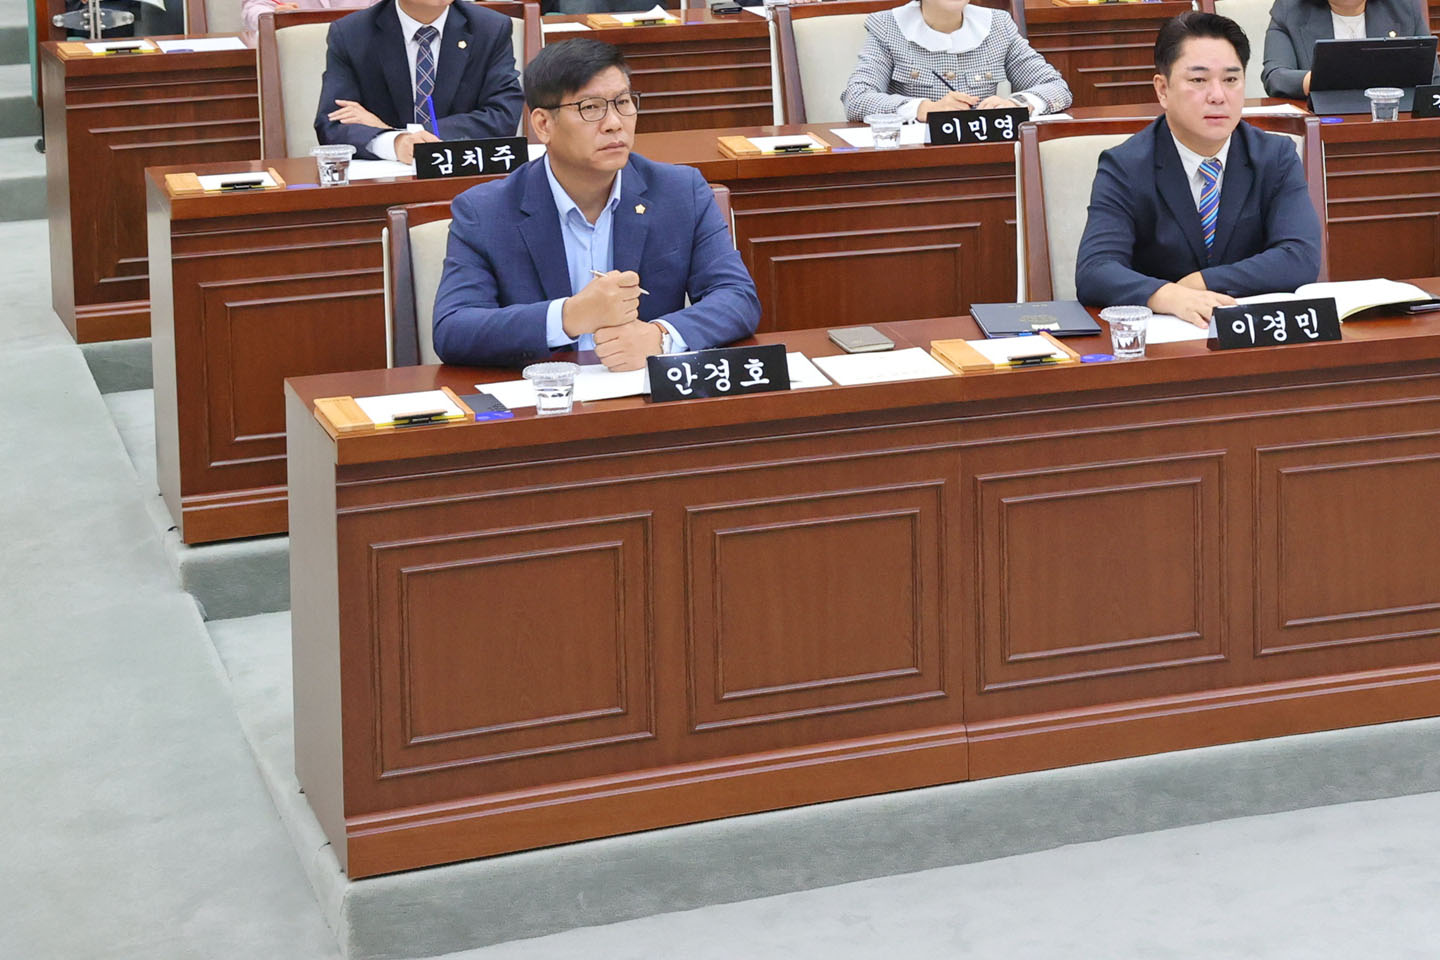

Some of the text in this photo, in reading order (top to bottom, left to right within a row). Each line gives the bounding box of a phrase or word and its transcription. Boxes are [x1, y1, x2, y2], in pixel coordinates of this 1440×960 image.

[941, 114, 1014, 142] 이민영
[431, 144, 516, 175] 김치주
[1231, 307, 1319, 345] 이경민
[666, 358, 771, 396] 안경호
